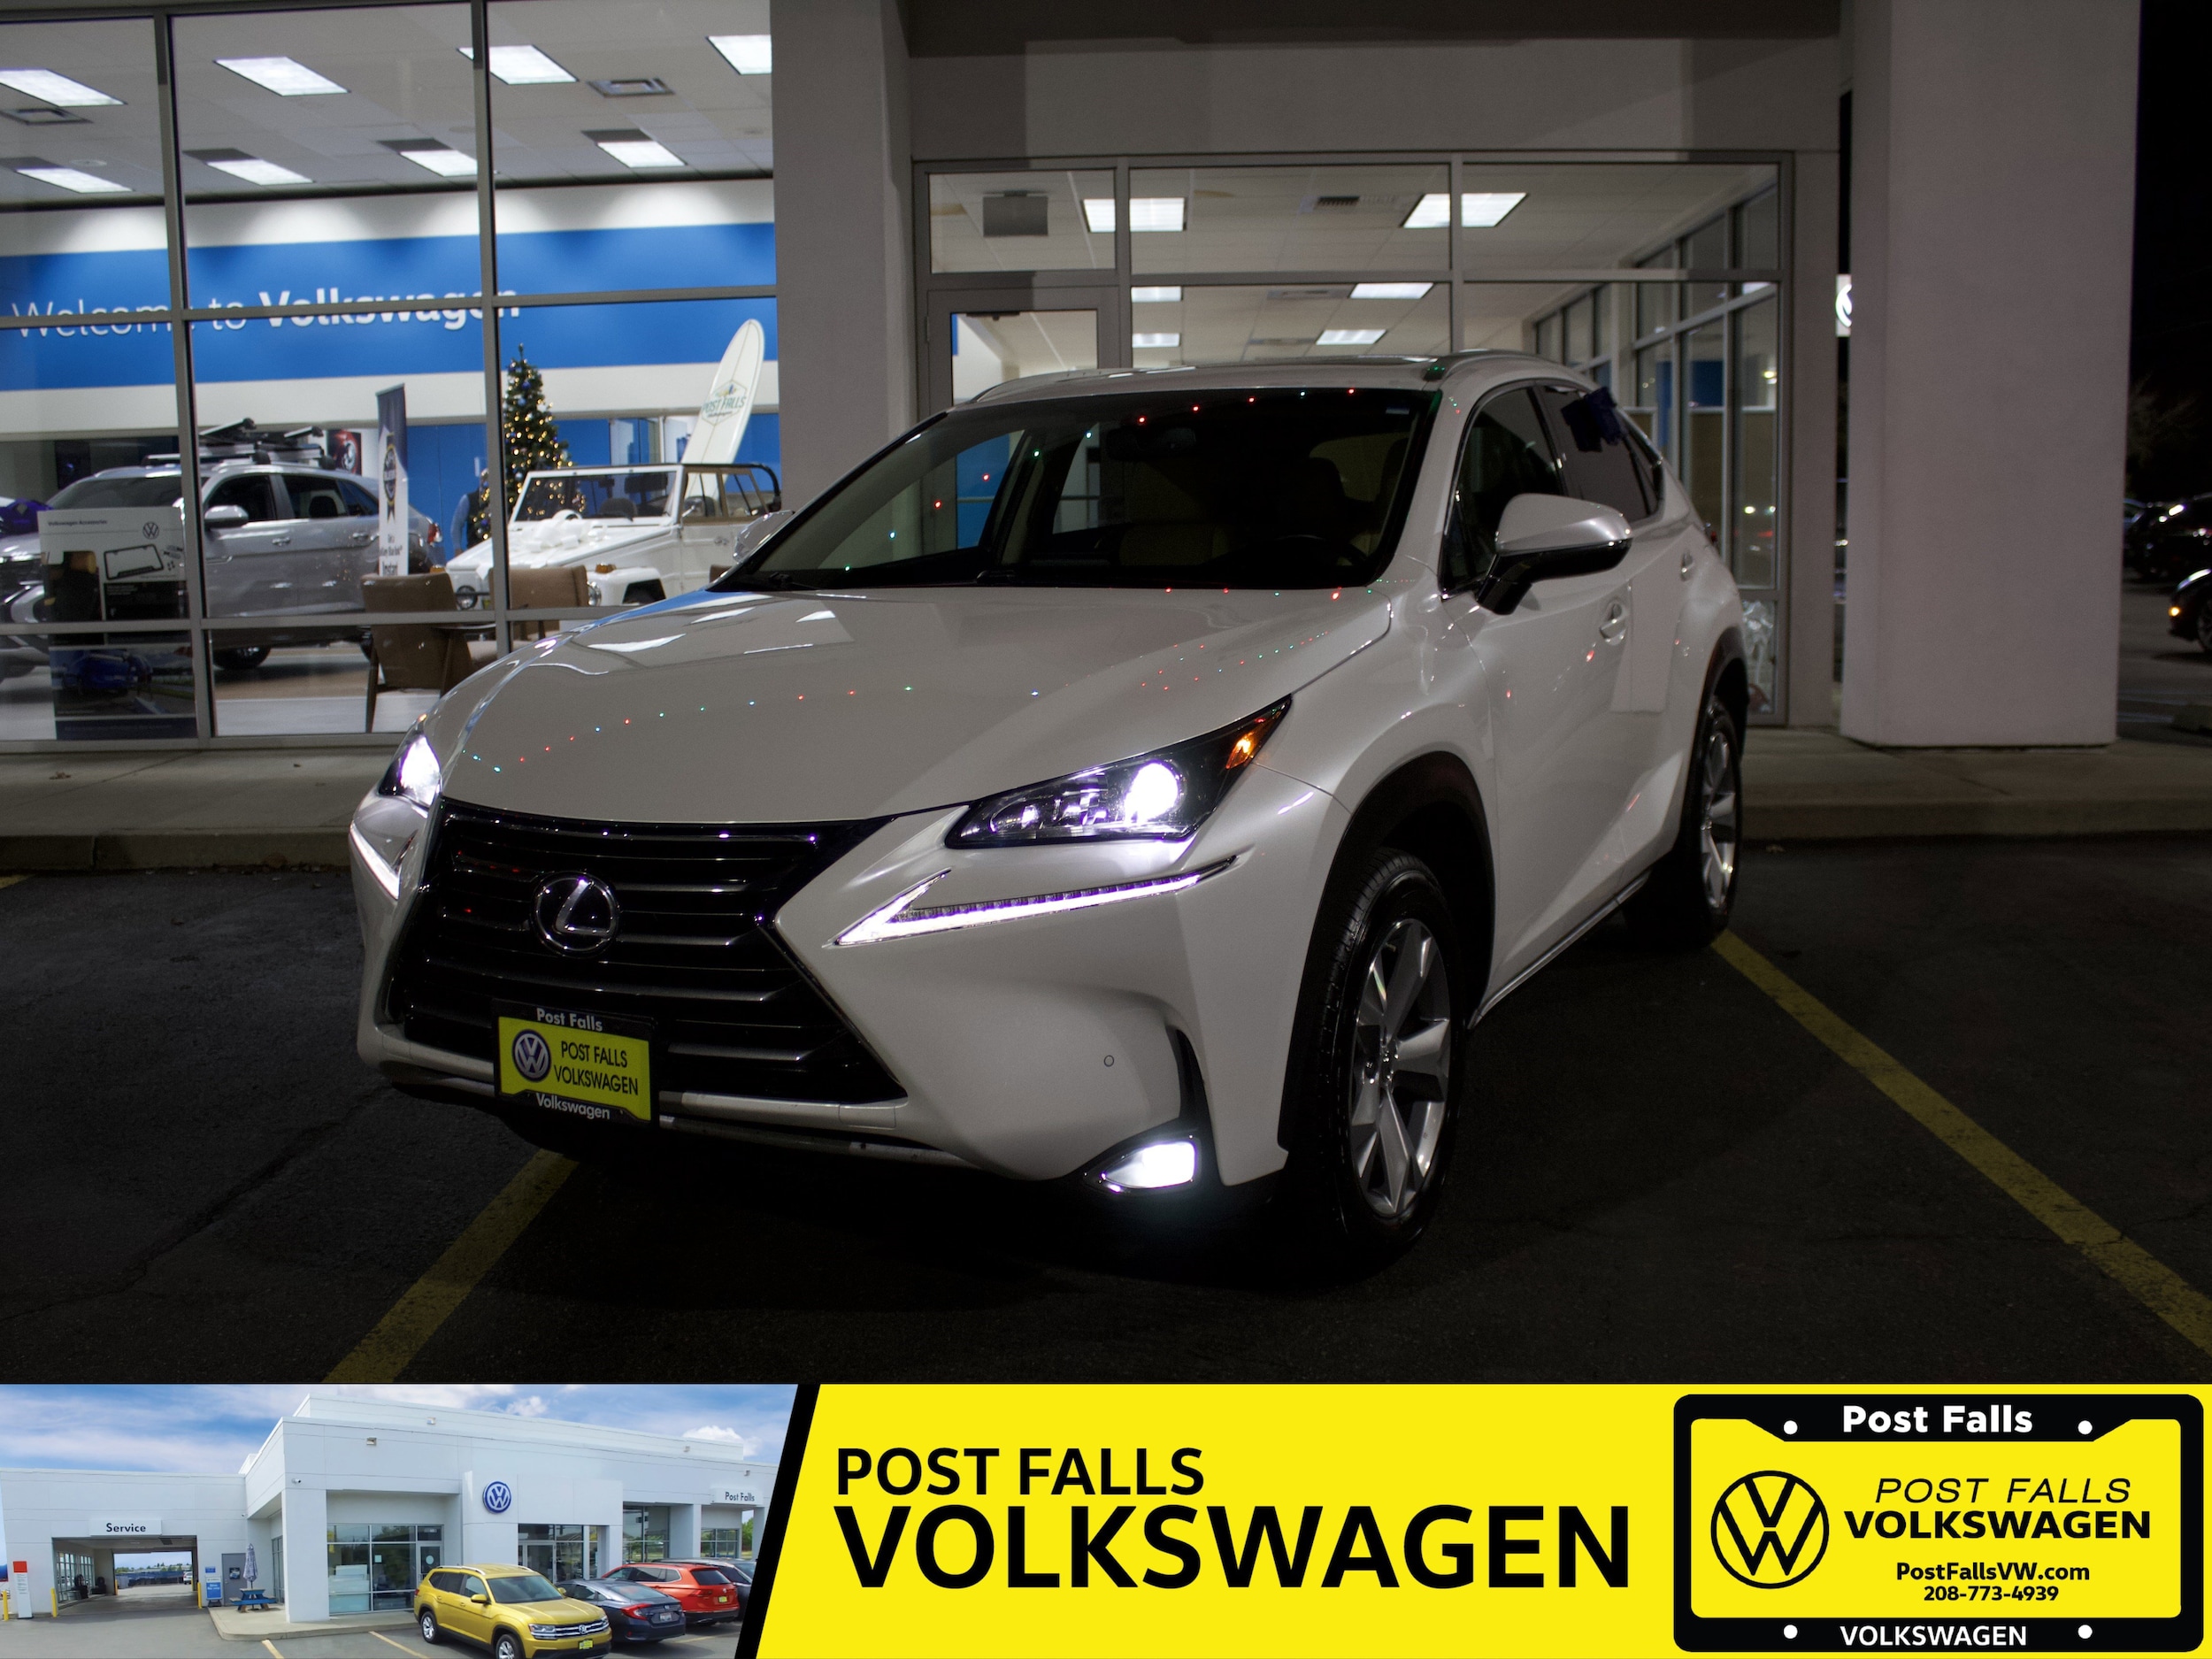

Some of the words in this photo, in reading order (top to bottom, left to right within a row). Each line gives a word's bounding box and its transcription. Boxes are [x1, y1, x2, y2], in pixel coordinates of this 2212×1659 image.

[12, 299, 196, 338] Welcom
[720, 396, 747, 410] FALLS
[536, 1008, 565, 1025] Post
[569, 1013, 603, 1032] Falls
[561, 1041, 590, 1062] POST
[594, 1047, 627, 1068] FALLS
[554, 1065, 639, 1095] VOLKSWAGEN
[535, 1092, 611, 1120] Volkswagen
